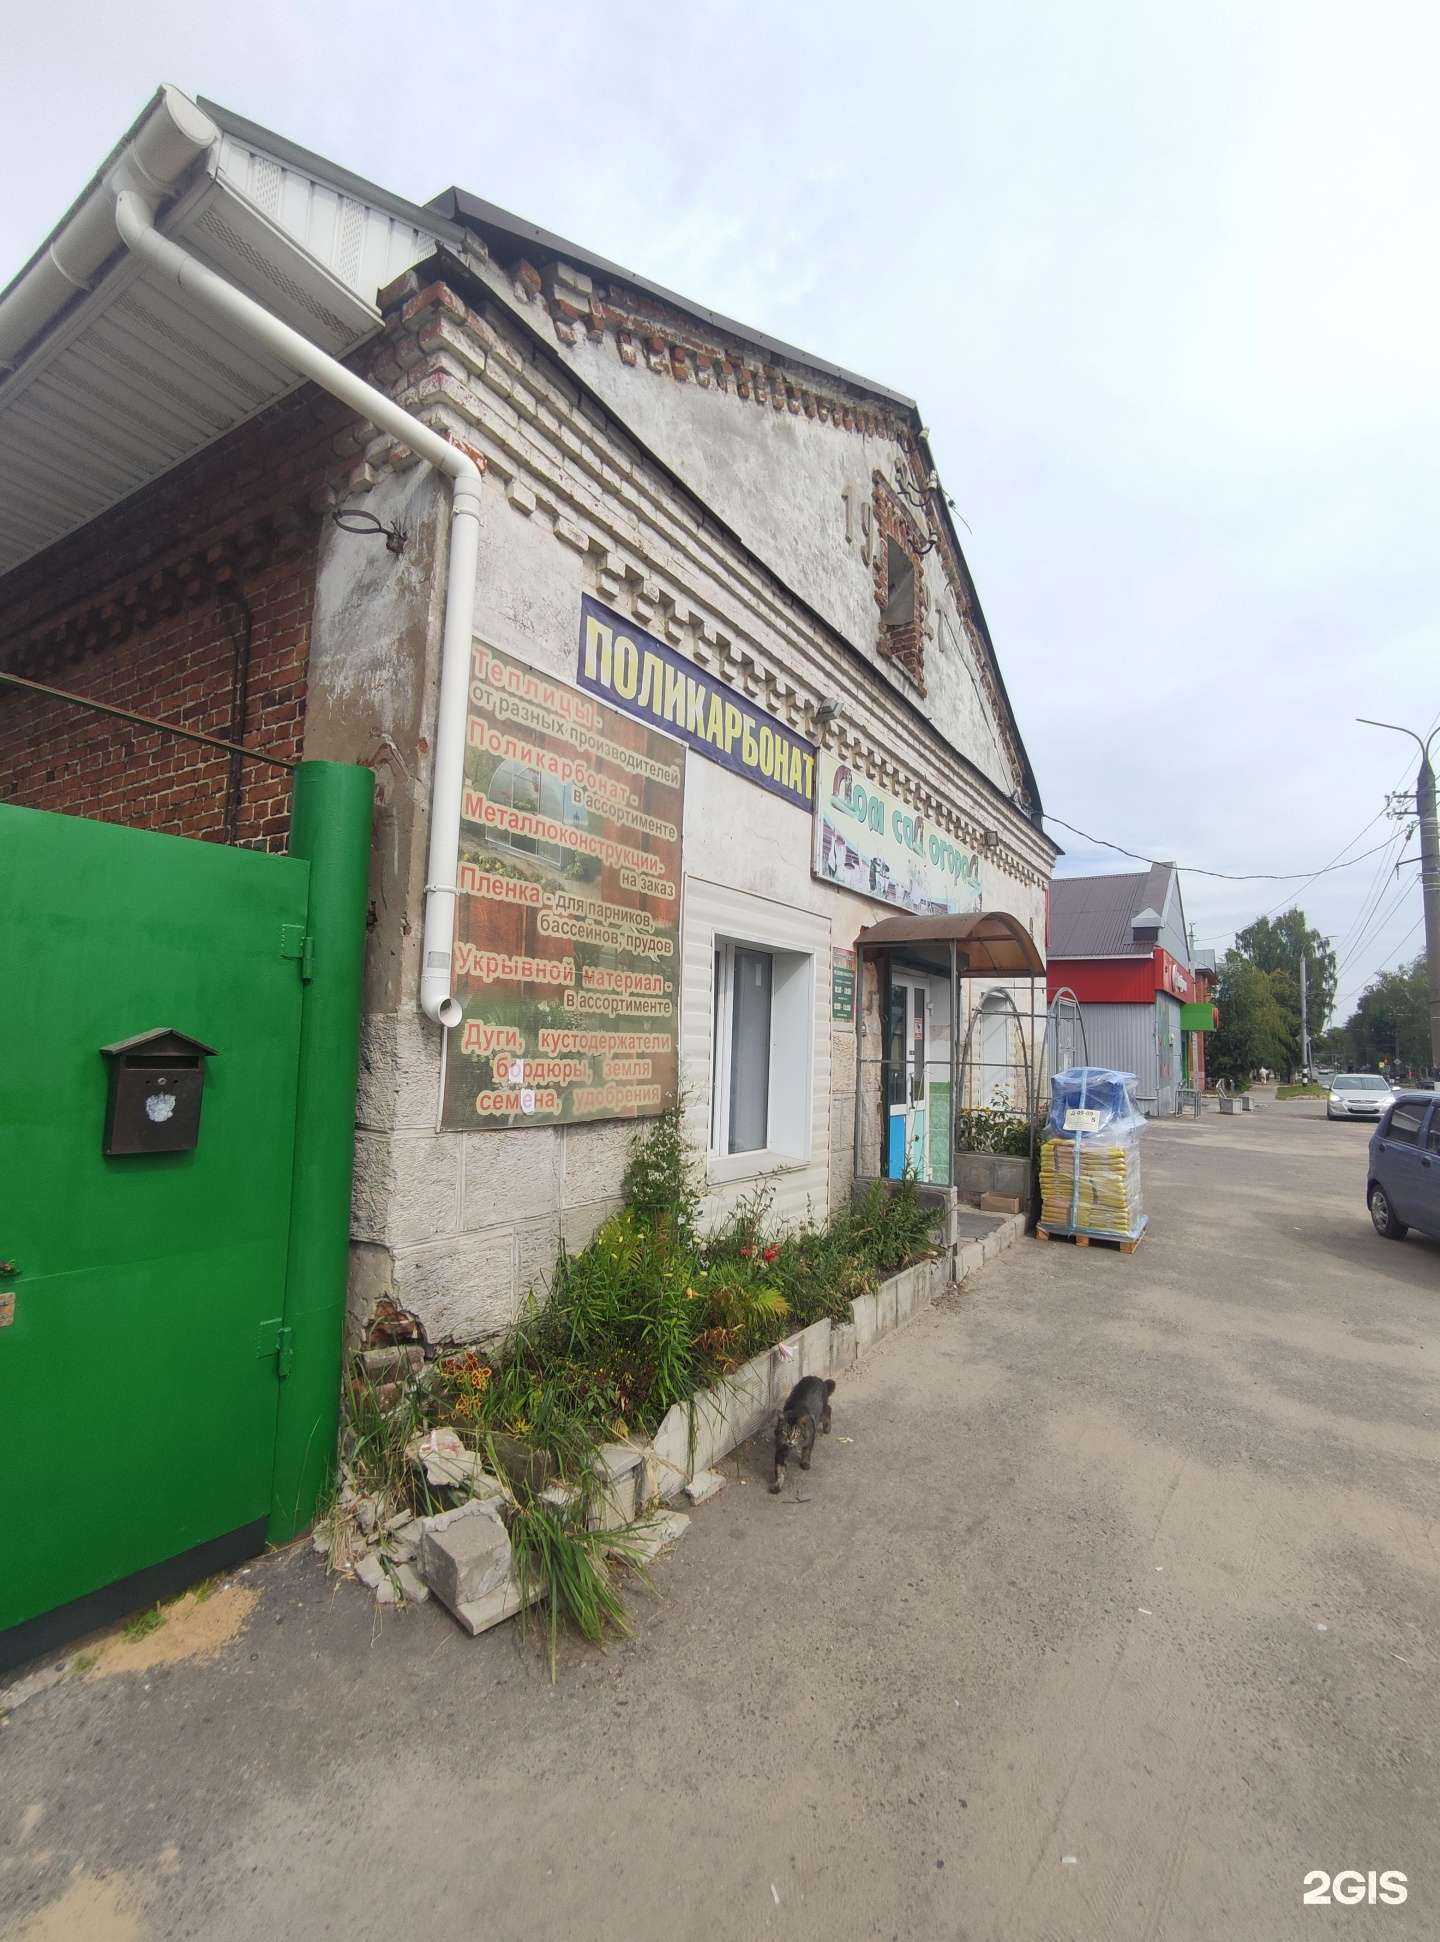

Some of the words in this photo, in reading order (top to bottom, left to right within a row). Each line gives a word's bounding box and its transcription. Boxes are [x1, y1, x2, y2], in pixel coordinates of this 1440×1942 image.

[584, 615, 815, 800] ПОЛИКАРБОНАТ
[472, 686, 494, 705] от
[499, 696, 564, 735] разных
[569, 726, 680, 785] производителей
[586, 792, 676, 839] ассортименте
[621, 871, 637, 888] на
[640, 878, 674, 897] заказ
[555, 894, 584, 912] для
[588, 902, 654, 929] парников,
[626, 934, 672, 953] прудов
[457, 946, 574, 982] Укрывной
[566, 992, 575, 1007] в
[580, 995, 671, 1014] ассортименте
[464, 1023, 524, 1049] Дуги,
[541, 1031, 671, 1053] кустодержатели
[605, 1062, 651, 1077] земля
[574, 1086, 660, 1110] удобрения
